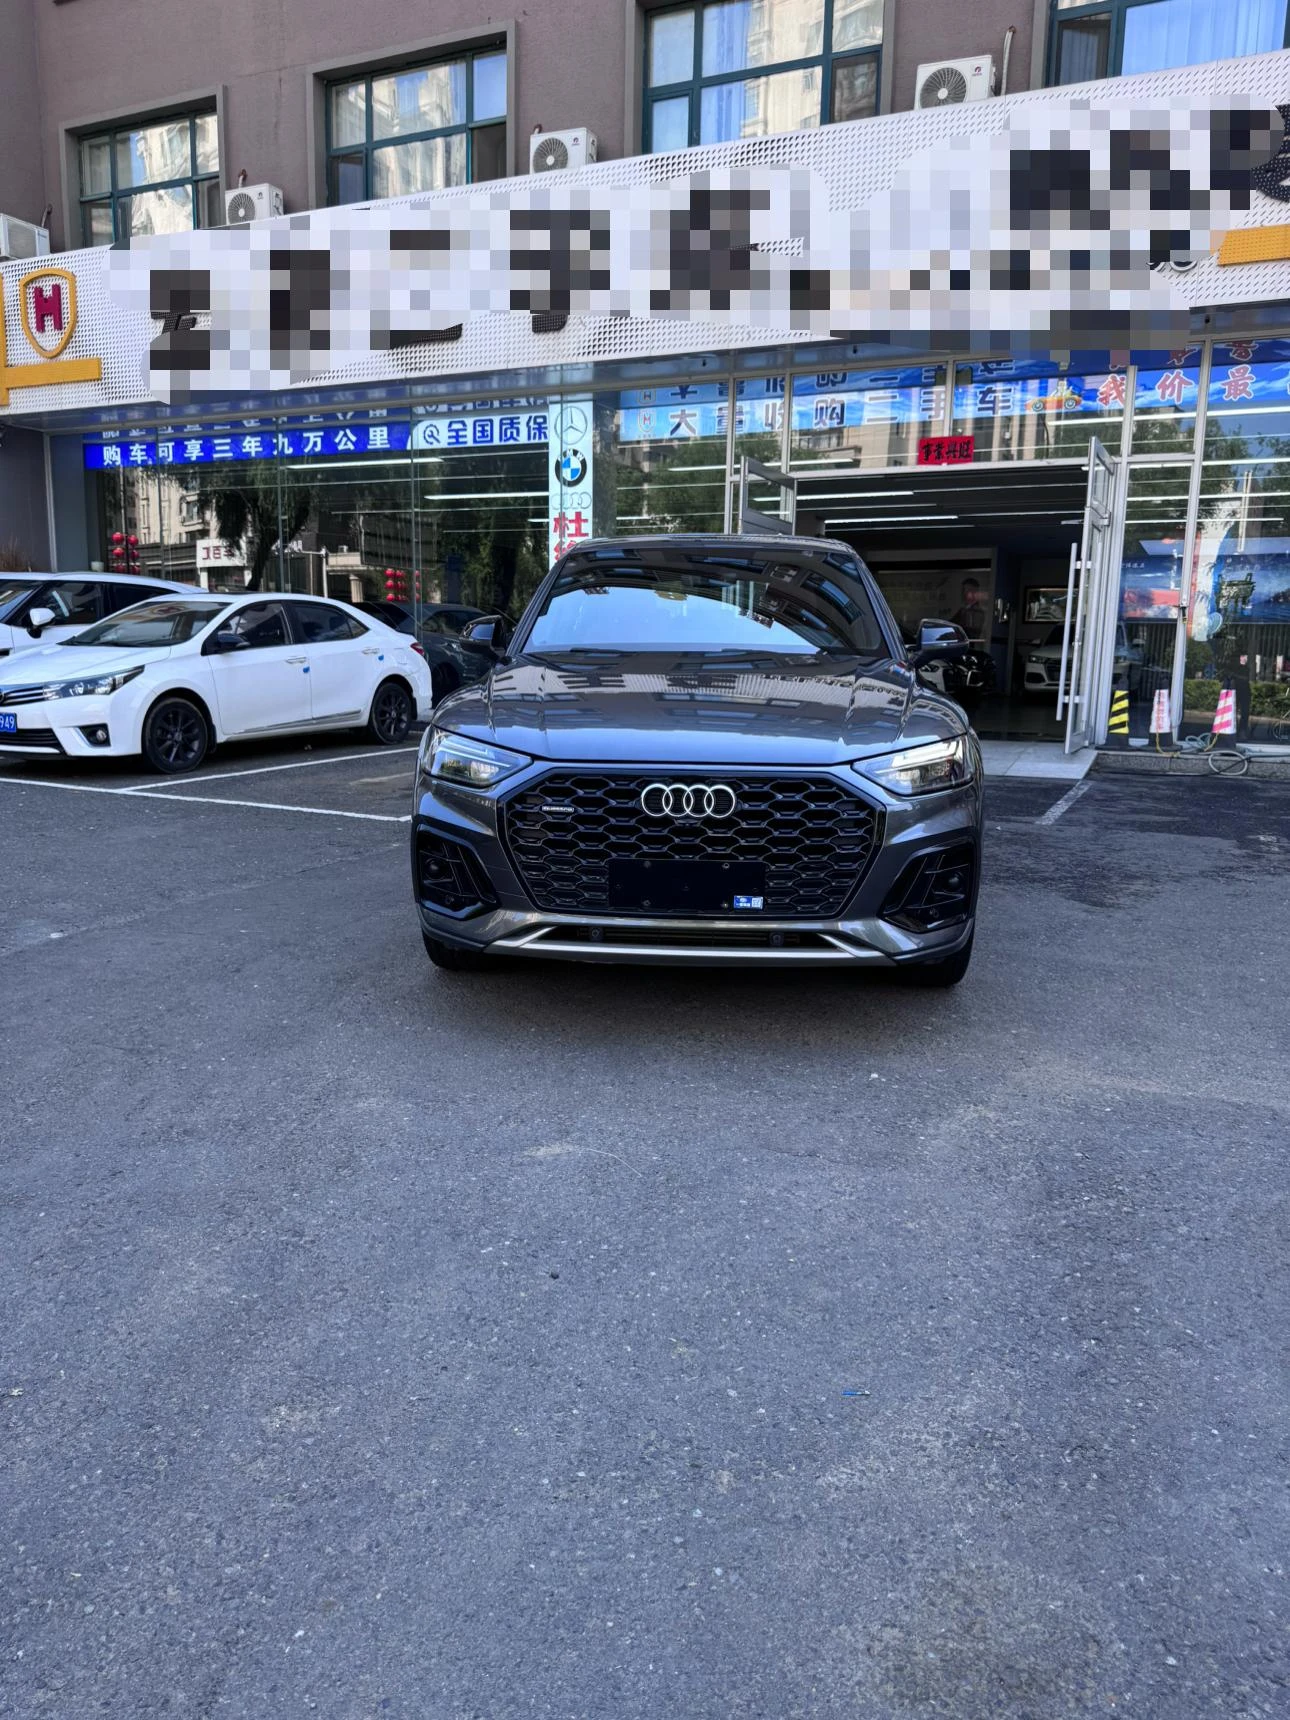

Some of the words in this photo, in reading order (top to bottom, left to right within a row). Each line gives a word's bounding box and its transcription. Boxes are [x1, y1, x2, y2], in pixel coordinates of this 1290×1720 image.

[34, 283, 63, 333] H
[103, 426, 391, 466] 购车可享三年九万公里
[447, 414, 548, 446] 全国质保
